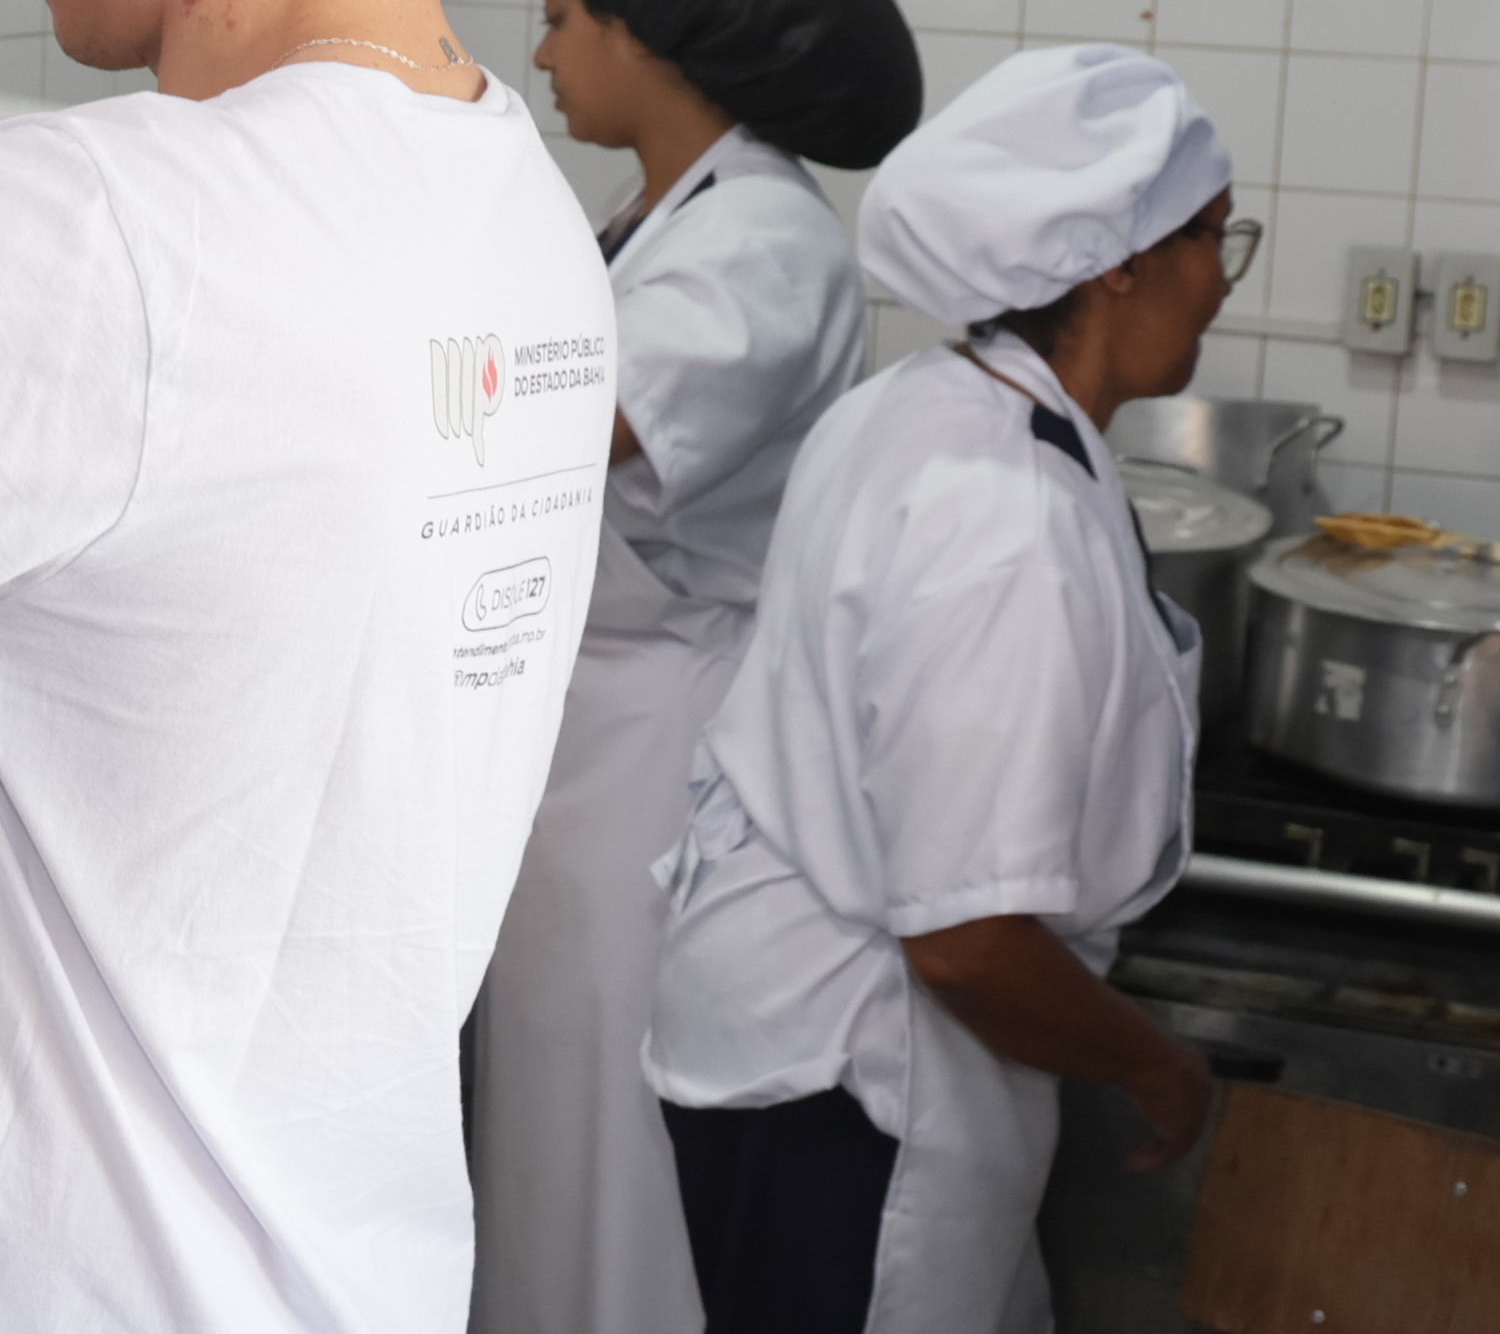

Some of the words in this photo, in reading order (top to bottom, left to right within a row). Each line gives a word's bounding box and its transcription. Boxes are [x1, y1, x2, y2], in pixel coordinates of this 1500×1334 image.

[514, 336, 569, 366] MINISTÉRIO
[571, 332, 605, 359] PÚBLICO
[514, 375, 528, 397] DO
[530, 369, 568, 395] ESTADO
[570, 368, 581, 388] DA
[583, 365, 605, 387] BAHIA
[421, 505, 505, 539] GUARDIÃO
[511, 503, 526, 522] DA
[532, 486, 592, 517] CIDADANIA
[526, 575, 546, 600] 127
